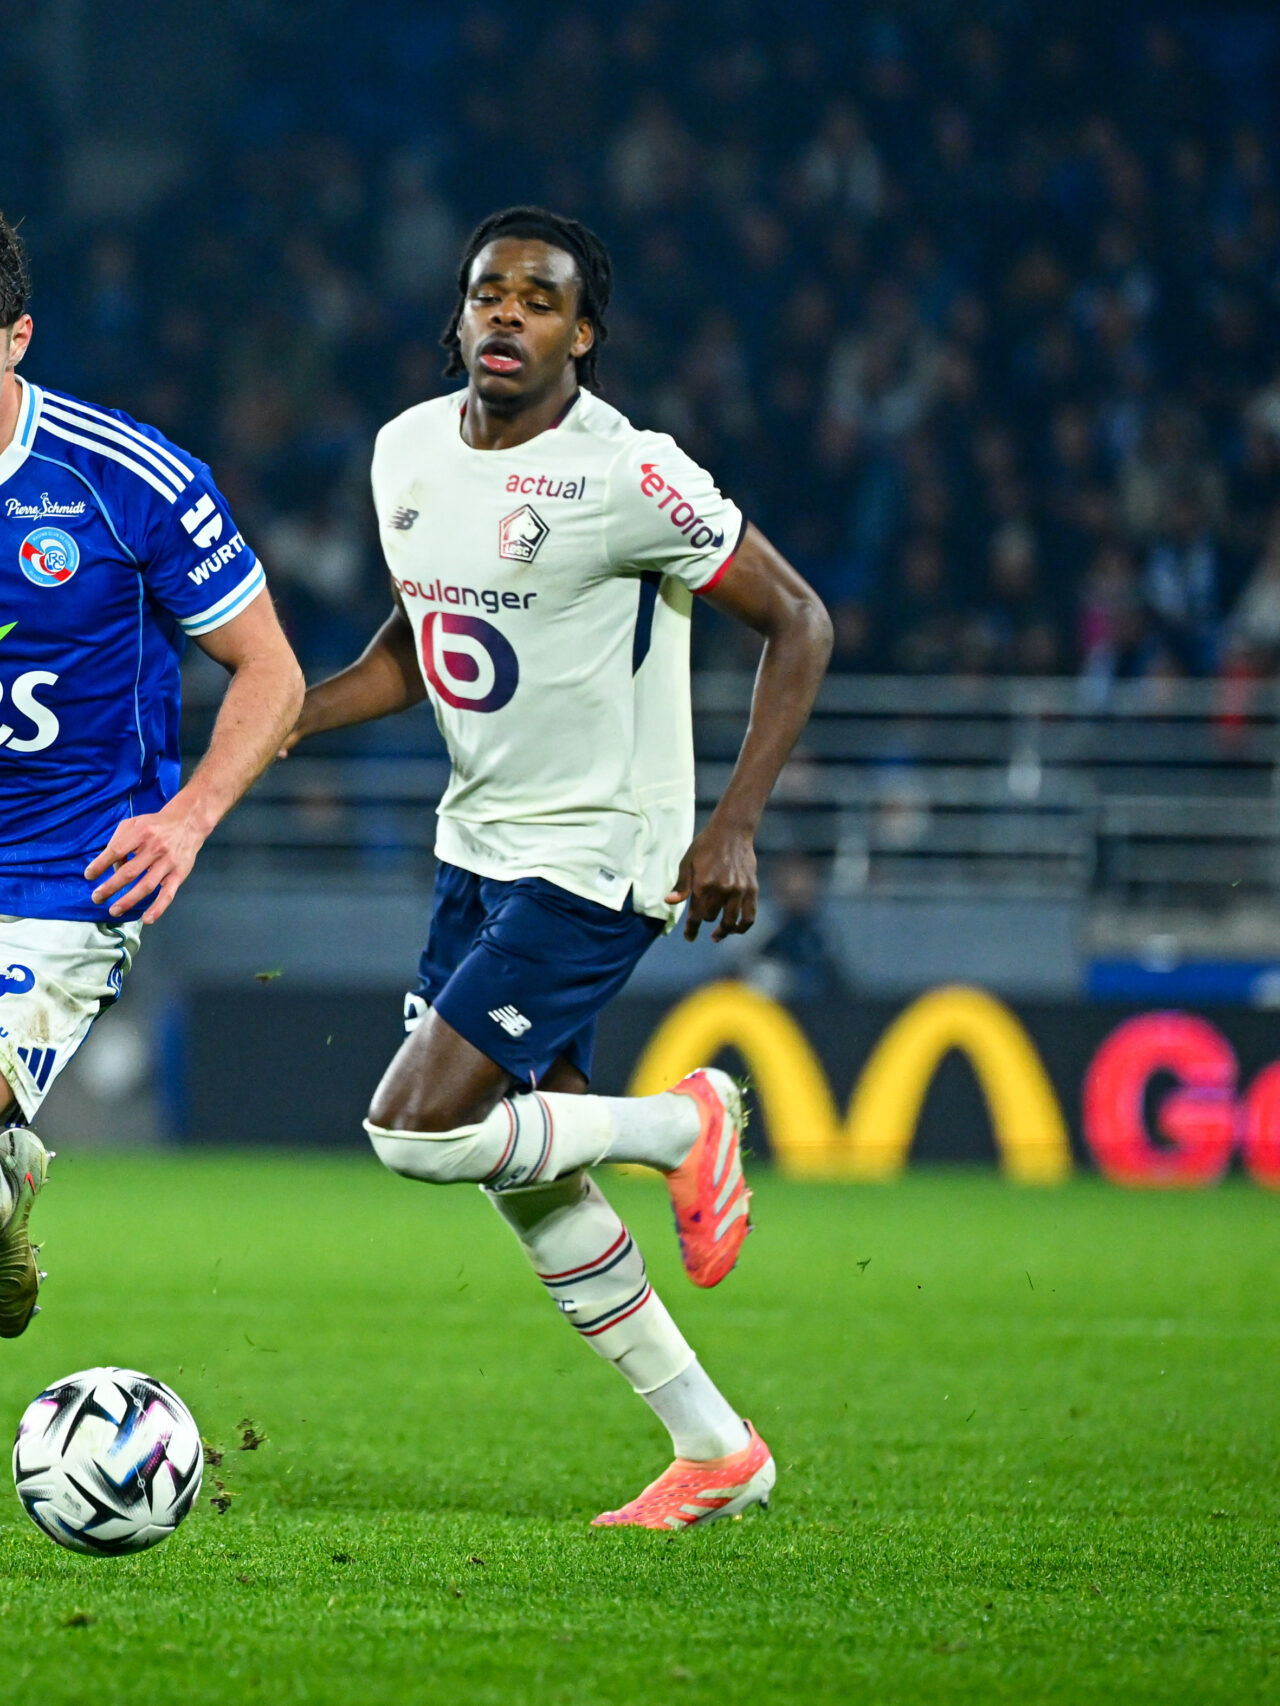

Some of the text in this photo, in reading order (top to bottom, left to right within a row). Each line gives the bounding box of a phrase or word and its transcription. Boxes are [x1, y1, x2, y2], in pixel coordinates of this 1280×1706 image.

[505, 474, 586, 500] actual
[5, 497, 86, 516] Pierre Schmidt
[1082, 1009, 1280, 1190] G
